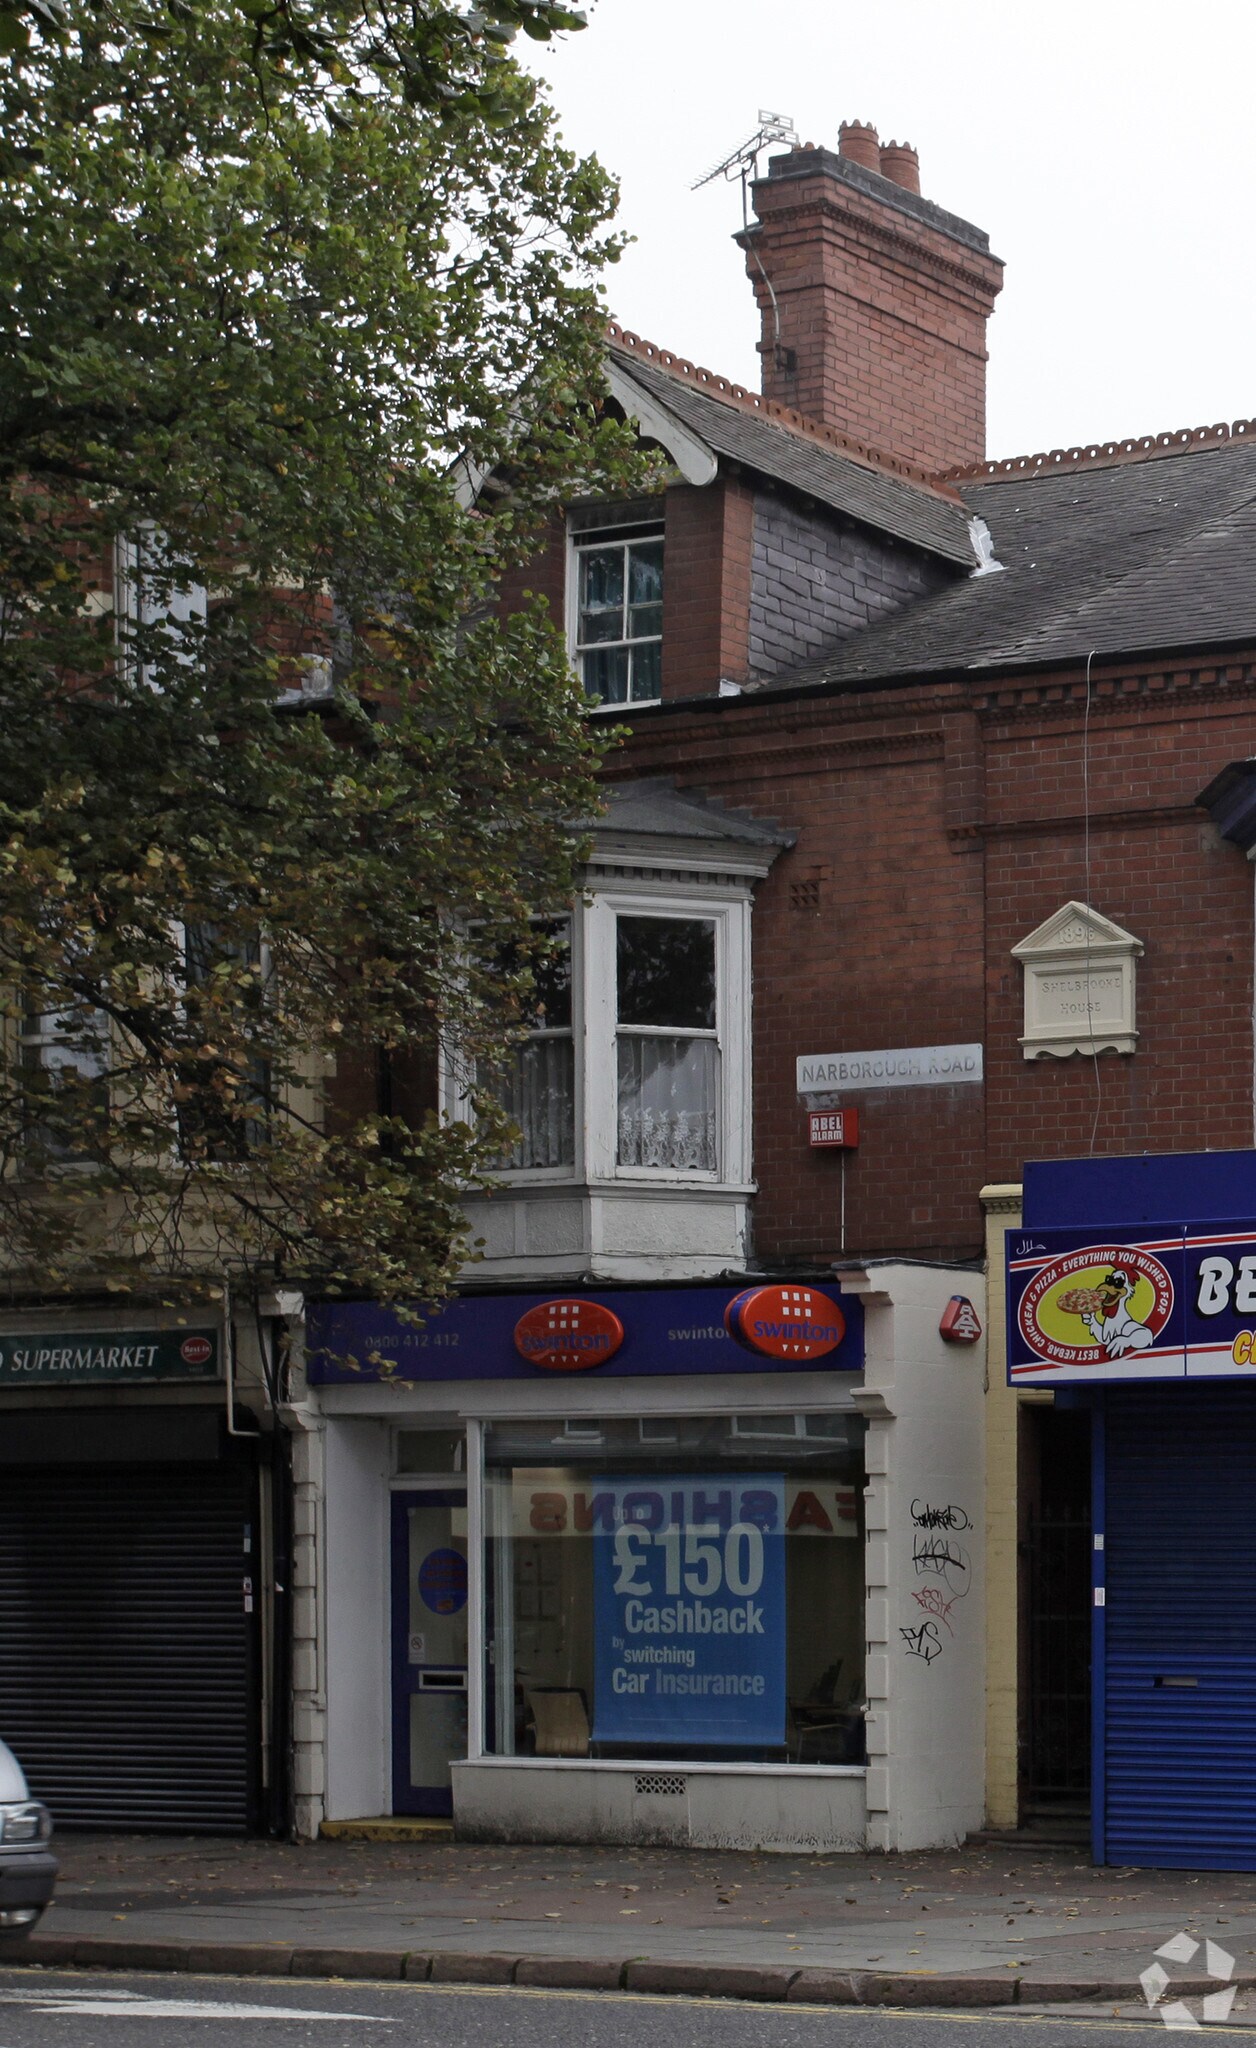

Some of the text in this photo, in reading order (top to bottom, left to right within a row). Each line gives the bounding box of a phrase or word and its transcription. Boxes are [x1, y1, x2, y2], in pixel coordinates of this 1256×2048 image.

[1060, 1002, 1101, 1014] HOUSE
[802, 1056, 976, 1083] NARBOROUGH ROAD
[811, 1116, 842, 1131] ABEL
[812, 1130, 842, 1142] ALARM
[1062, 1250, 1116, 1273] EVERYTHING
[1118, 1251, 1136, 1264] YOU
[1034, 1269, 1058, 1294] PIZZA
[1136, 1256, 1167, 1288] WISHED
[1157, 1291, 1169, 1315] FOR
[668, 1325, 731, 1341] swinto
[754, 1320, 839, 1342] swinton
[1024, 1302, 1046, 1347] CHICKEN
[365, 1333, 460, 1349] 0800 412 412
[521, 1330, 610, 1351] swinton
[11, 1346, 159, 1371] SUPERMARKET
[1076, 1349, 1099, 1361] BEST
[625, 1600, 765, 1634] Cashback
[612, 1636, 625, 1649] by
[624, 1646, 696, 1668] switching
[612, 1667, 765, 1695] Car Insurance
